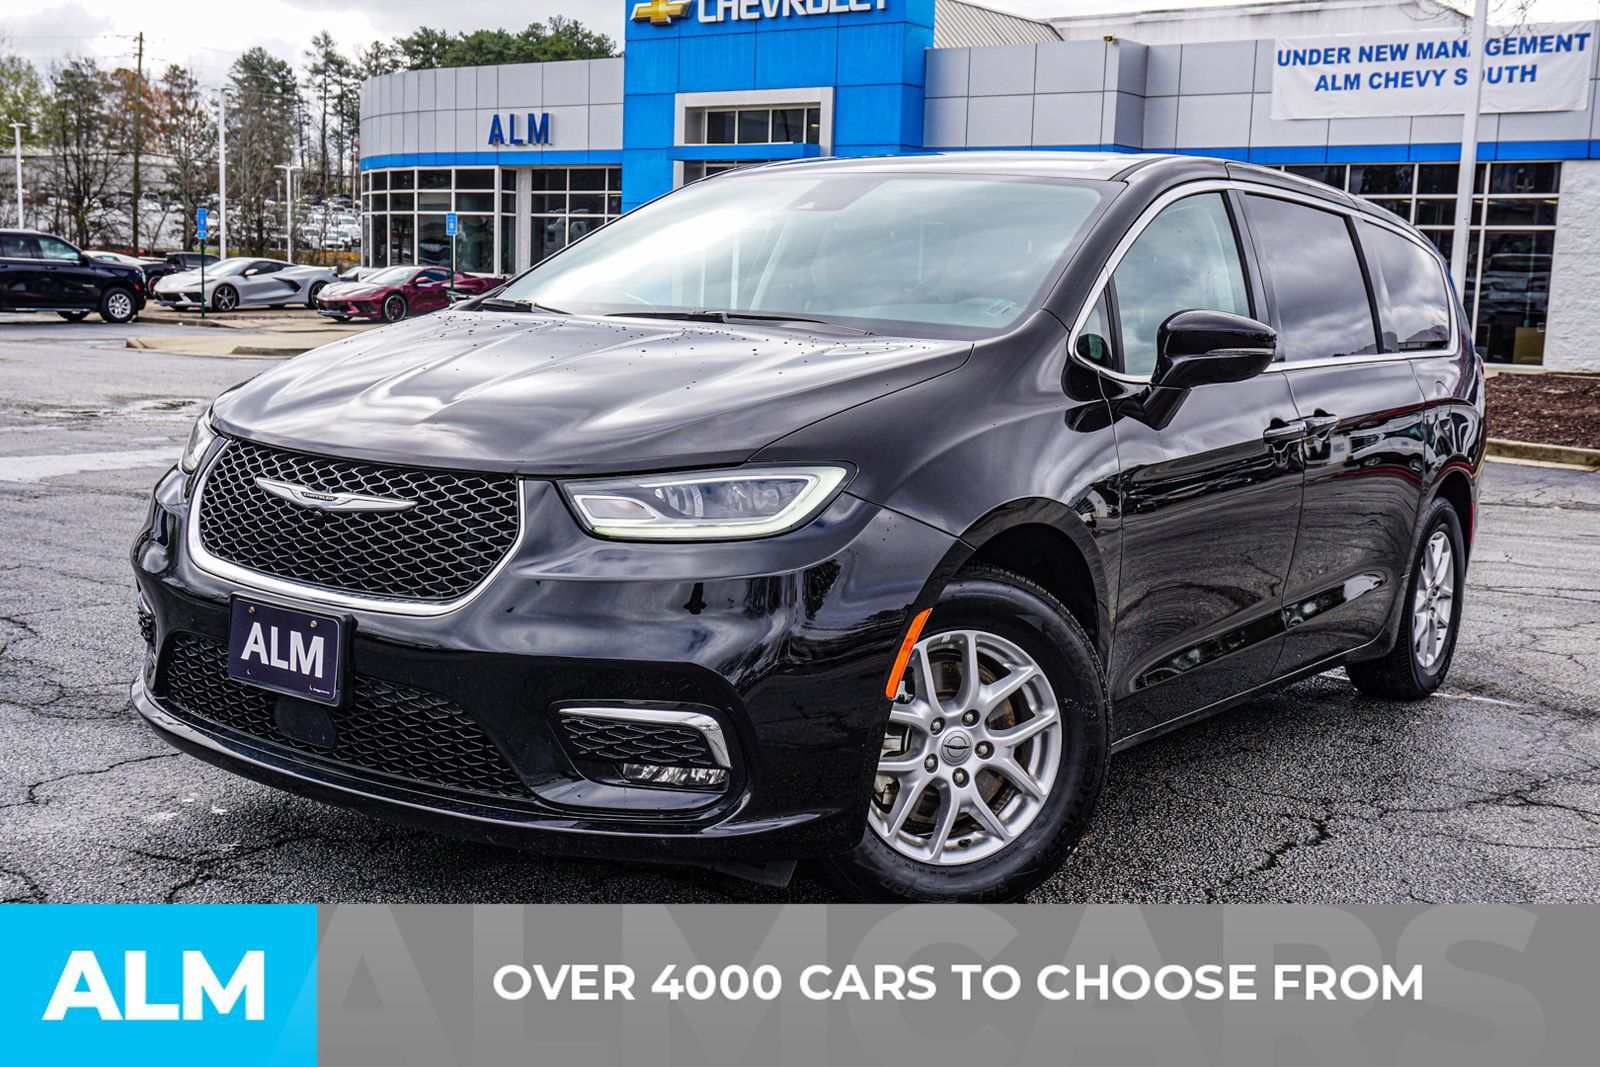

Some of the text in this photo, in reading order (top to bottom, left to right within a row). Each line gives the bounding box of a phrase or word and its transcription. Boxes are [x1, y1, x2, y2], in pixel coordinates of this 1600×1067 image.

[698, 0, 886, 23] CHEVR
[1277, 33, 1591, 67] UNDER NEW MANGEMENT
[1314, 64, 1537, 91] ALM CHEVY SUTH
[488, 112, 552, 146] ALM
[240, 621, 324, 679] ALM
